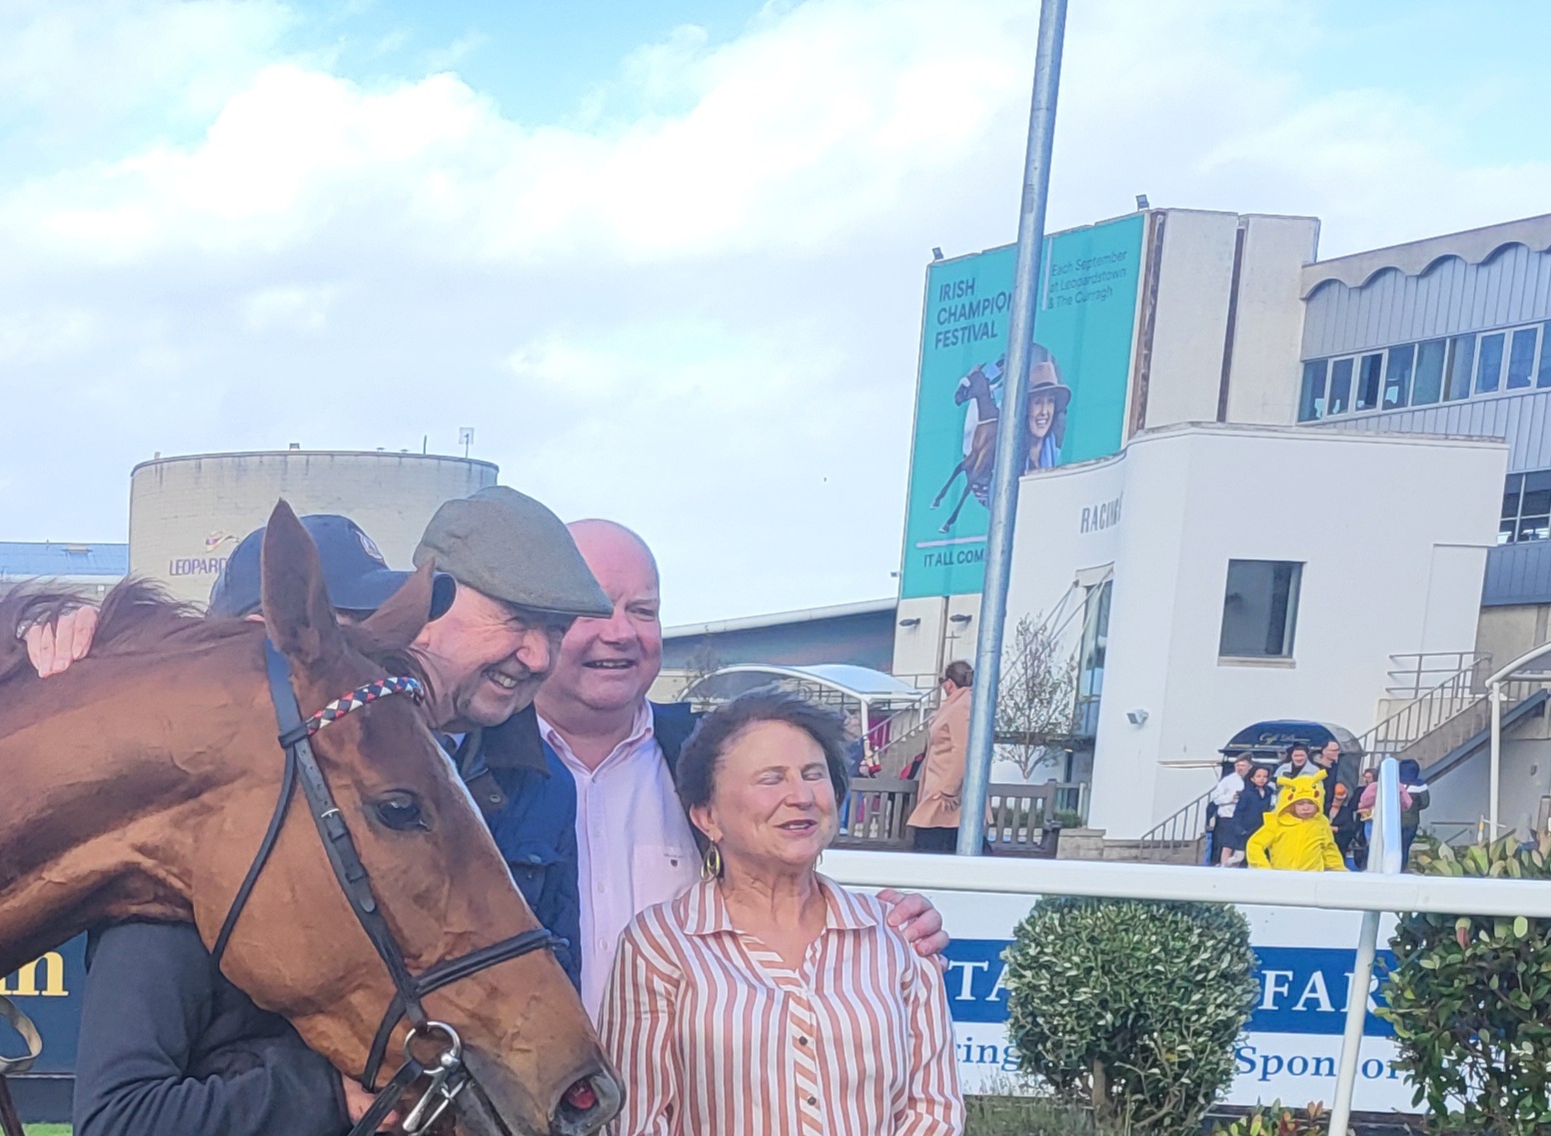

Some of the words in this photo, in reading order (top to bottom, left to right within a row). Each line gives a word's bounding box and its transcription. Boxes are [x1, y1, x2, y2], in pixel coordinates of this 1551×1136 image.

[1075, 250, 1127, 271] September
[939, 277, 975, 302] IRISH
[935, 319, 998, 349] FESTIVAL
[934, 552, 955, 567] ALL
